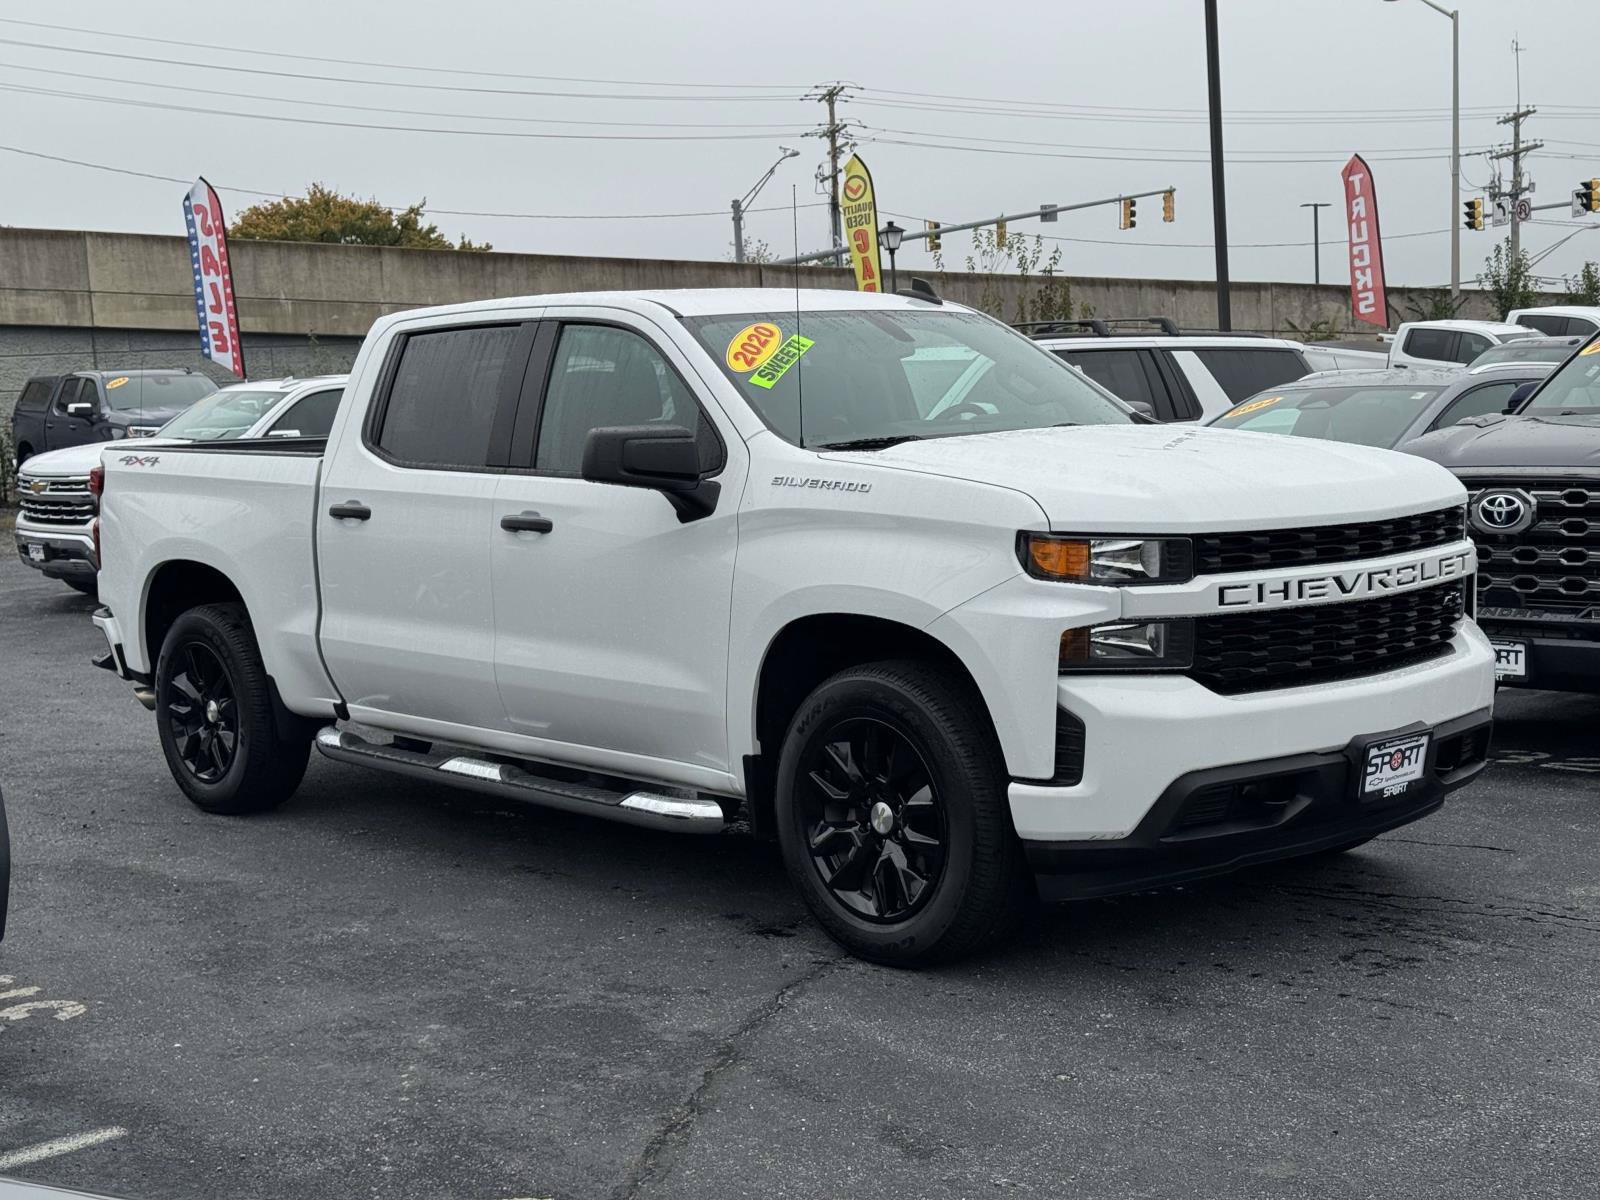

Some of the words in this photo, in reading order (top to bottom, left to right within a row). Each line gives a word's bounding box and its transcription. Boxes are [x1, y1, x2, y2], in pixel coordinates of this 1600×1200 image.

[733, 325, 775, 368] 2020
[757, 338, 808, 382] SWEET!
[771, 476, 872, 493] SILVERADO
[1218, 552, 1472, 608] CHEVROLET
[1366, 743, 1425, 777] SPORT
[1383, 782, 1409, 798] SPORT
